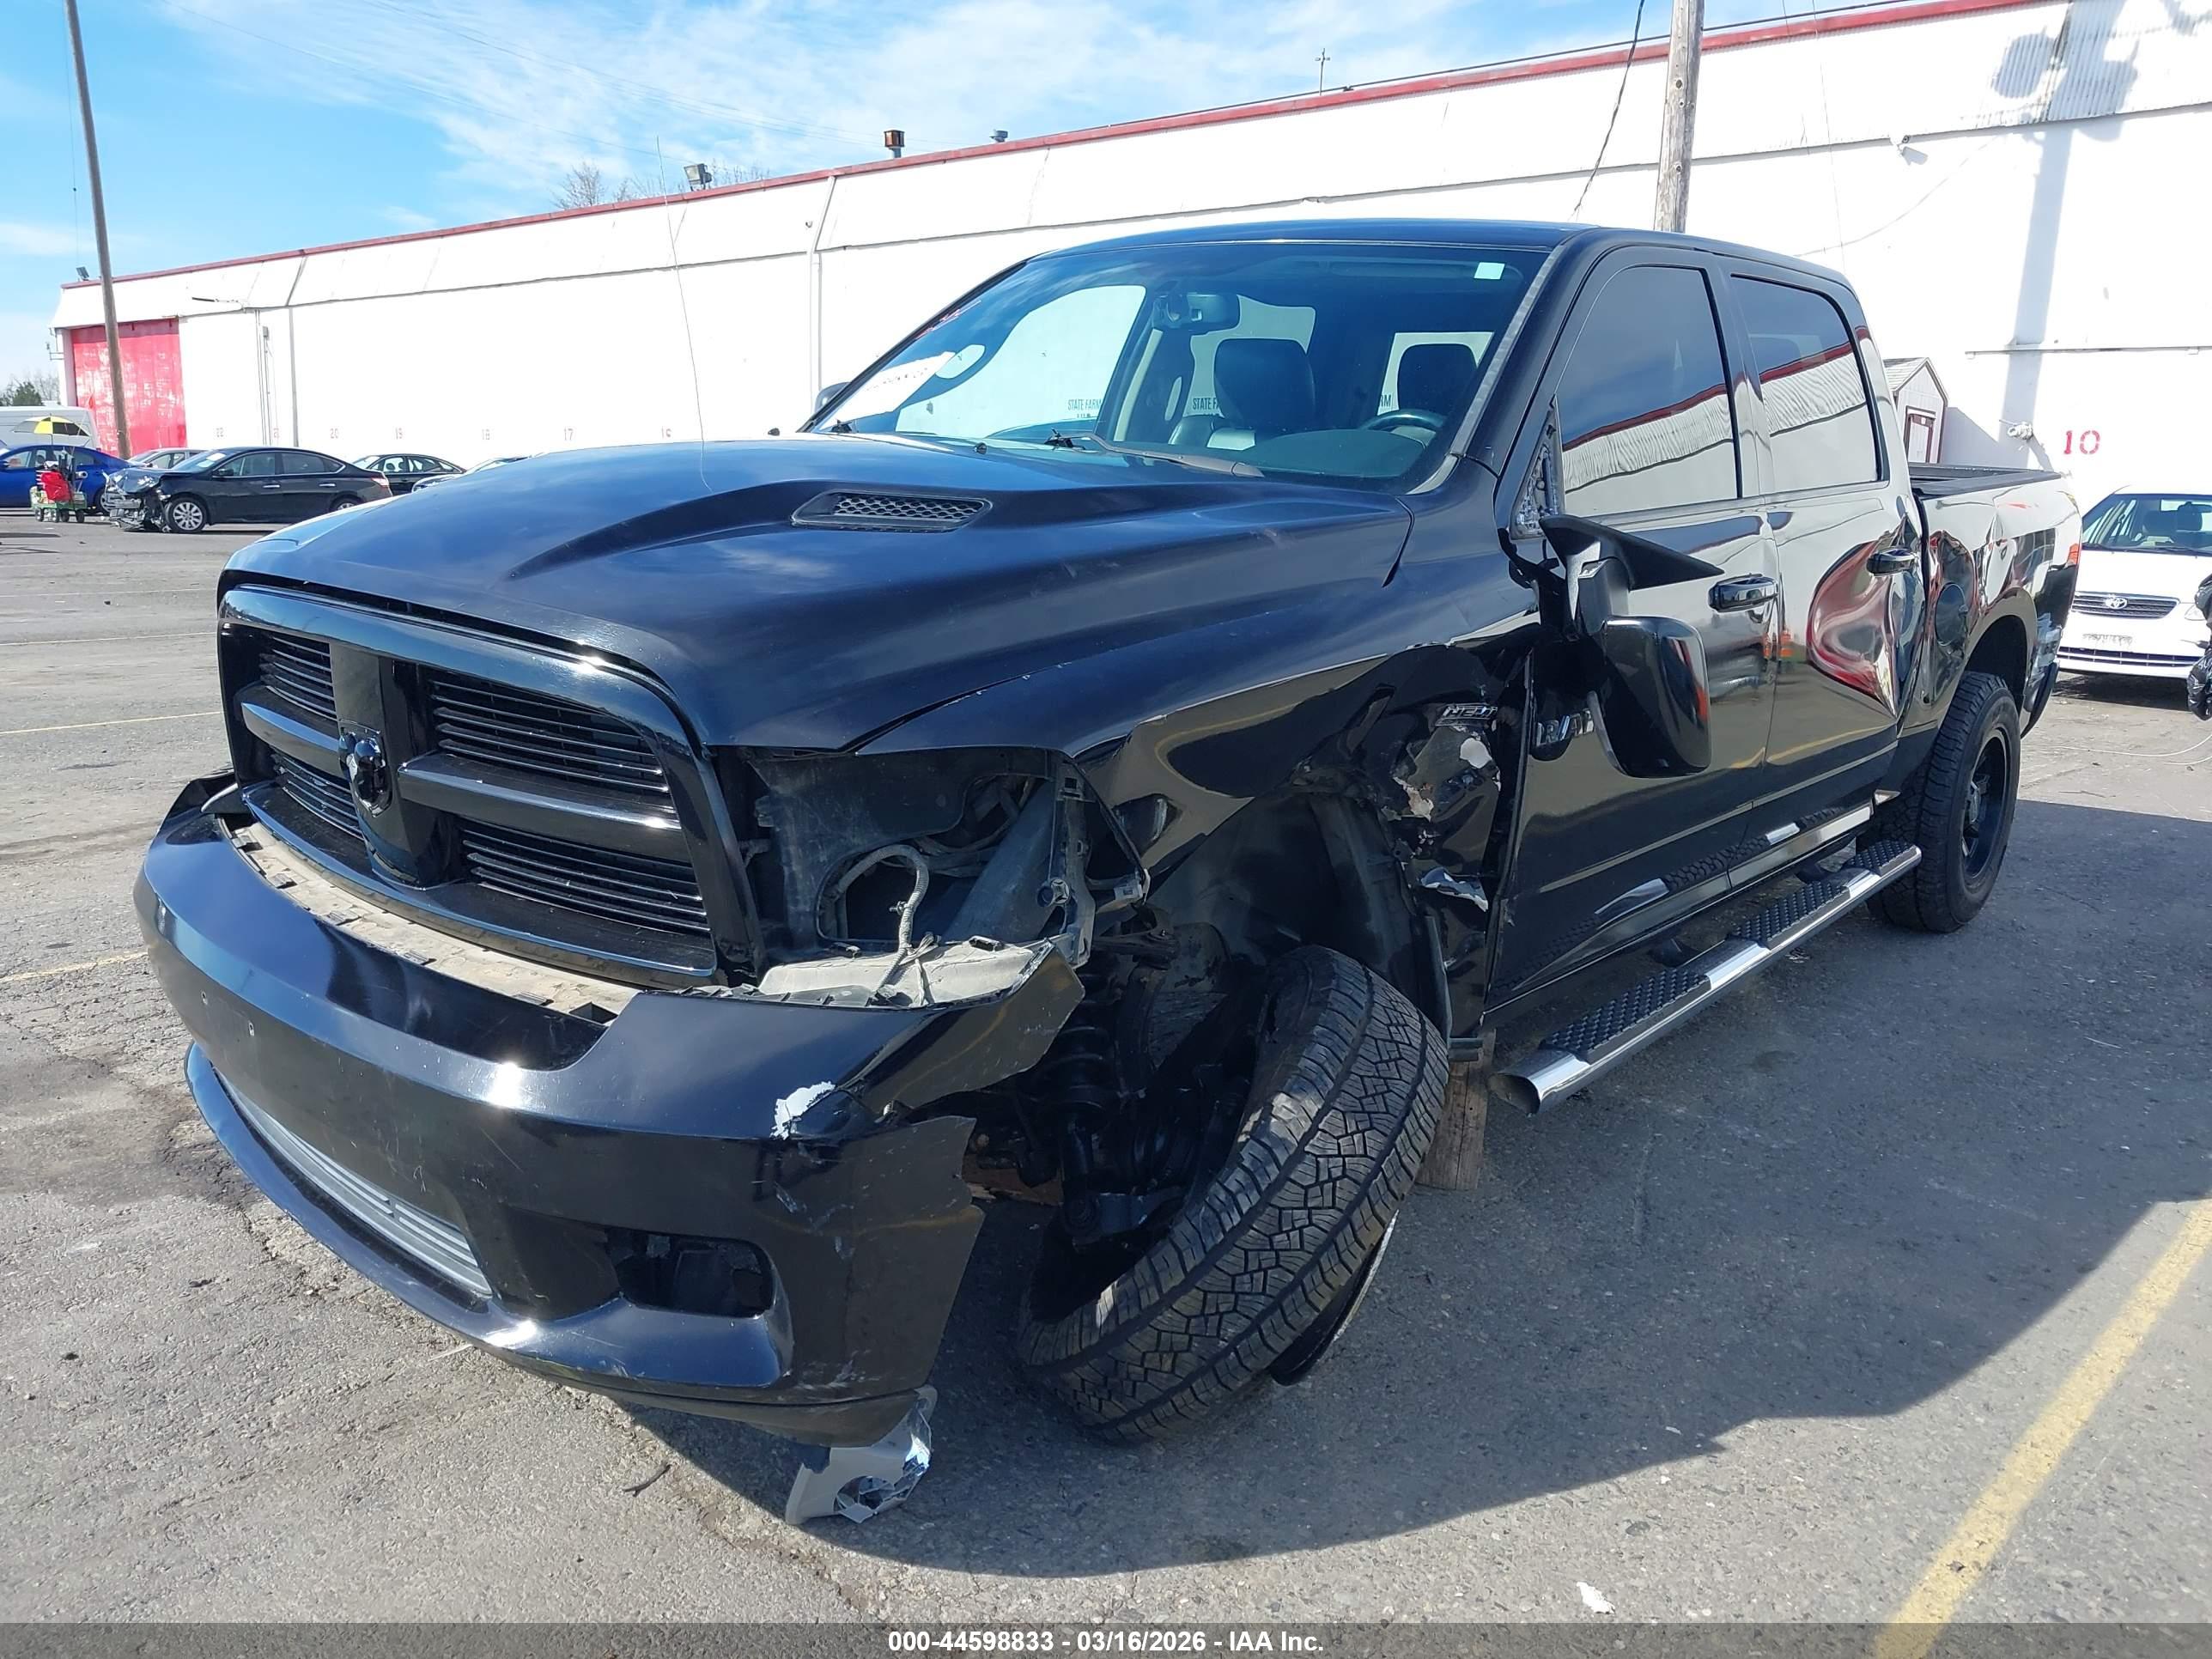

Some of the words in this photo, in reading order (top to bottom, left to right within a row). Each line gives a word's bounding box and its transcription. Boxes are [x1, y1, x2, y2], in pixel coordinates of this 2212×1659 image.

[1068, 399, 1084, 410] STATE
[1193, 398, 1211, 410] STATE
[564, 428, 574, 441] 17
[2063, 430, 2100, 454] 10
